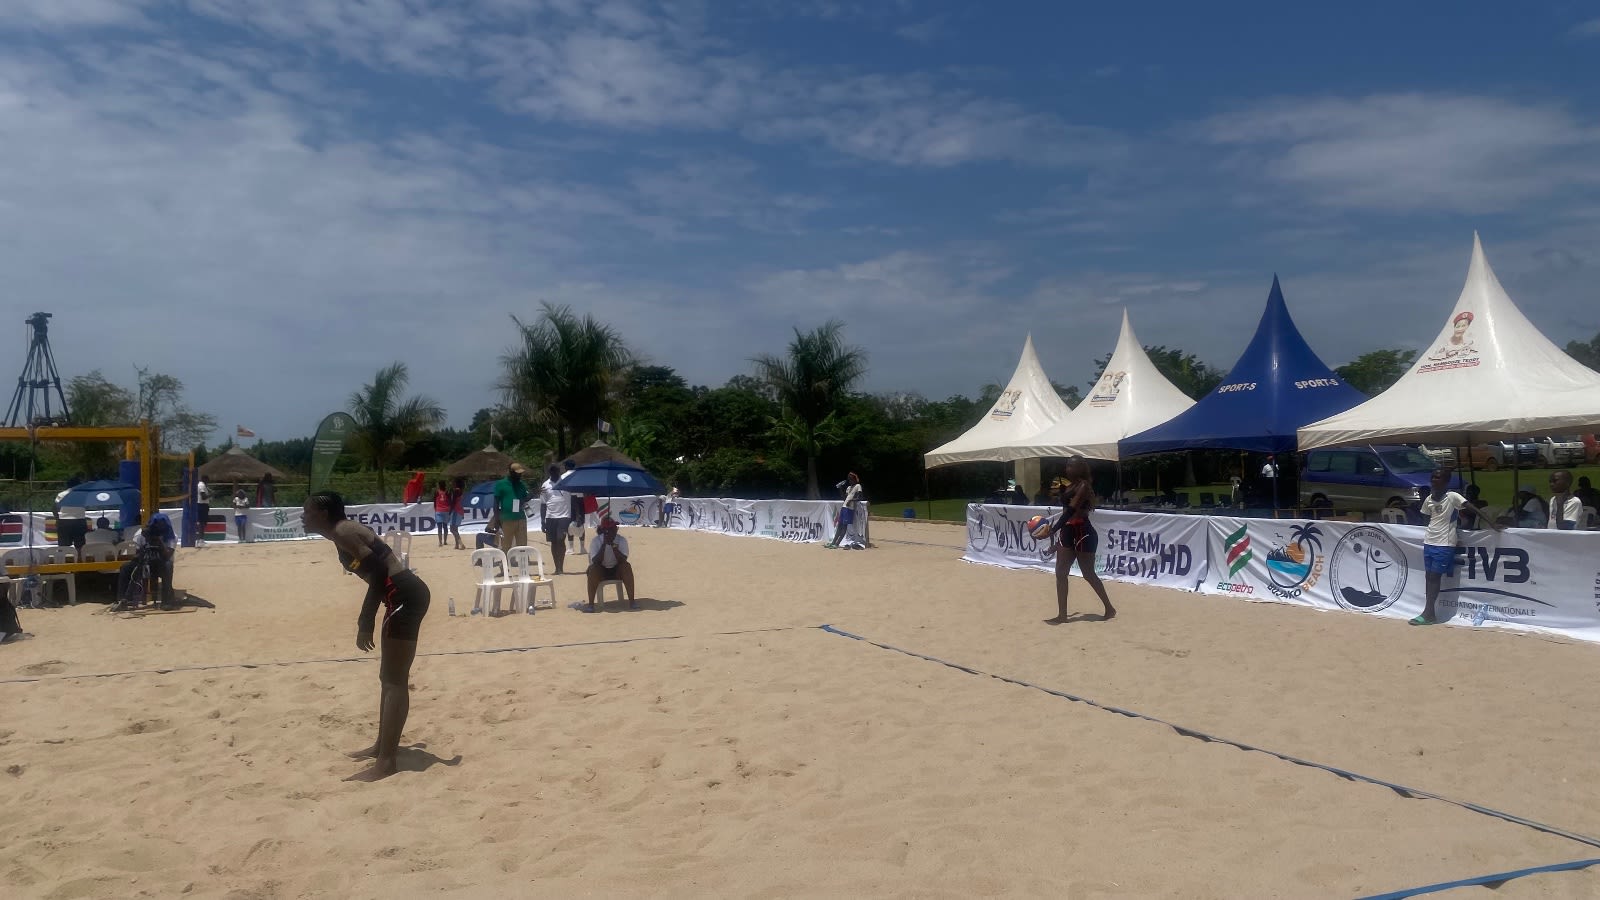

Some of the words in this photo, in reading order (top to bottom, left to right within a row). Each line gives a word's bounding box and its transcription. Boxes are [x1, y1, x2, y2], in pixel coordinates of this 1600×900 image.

[1218, 382, 1257, 394] SPORT-S
[1294, 378, 1339, 389] SPORT-S
[347, 512, 398, 525] TEAM
[399, 516, 436, 532] HD
[781, 515, 810, 529] S-TEAM
[1107, 528, 1160, 554] S-TEAM
[1104, 554, 1158, 579] MEDIA
[1160, 543, 1192, 576] HD
[1301, 555, 1325, 592] BEACH
